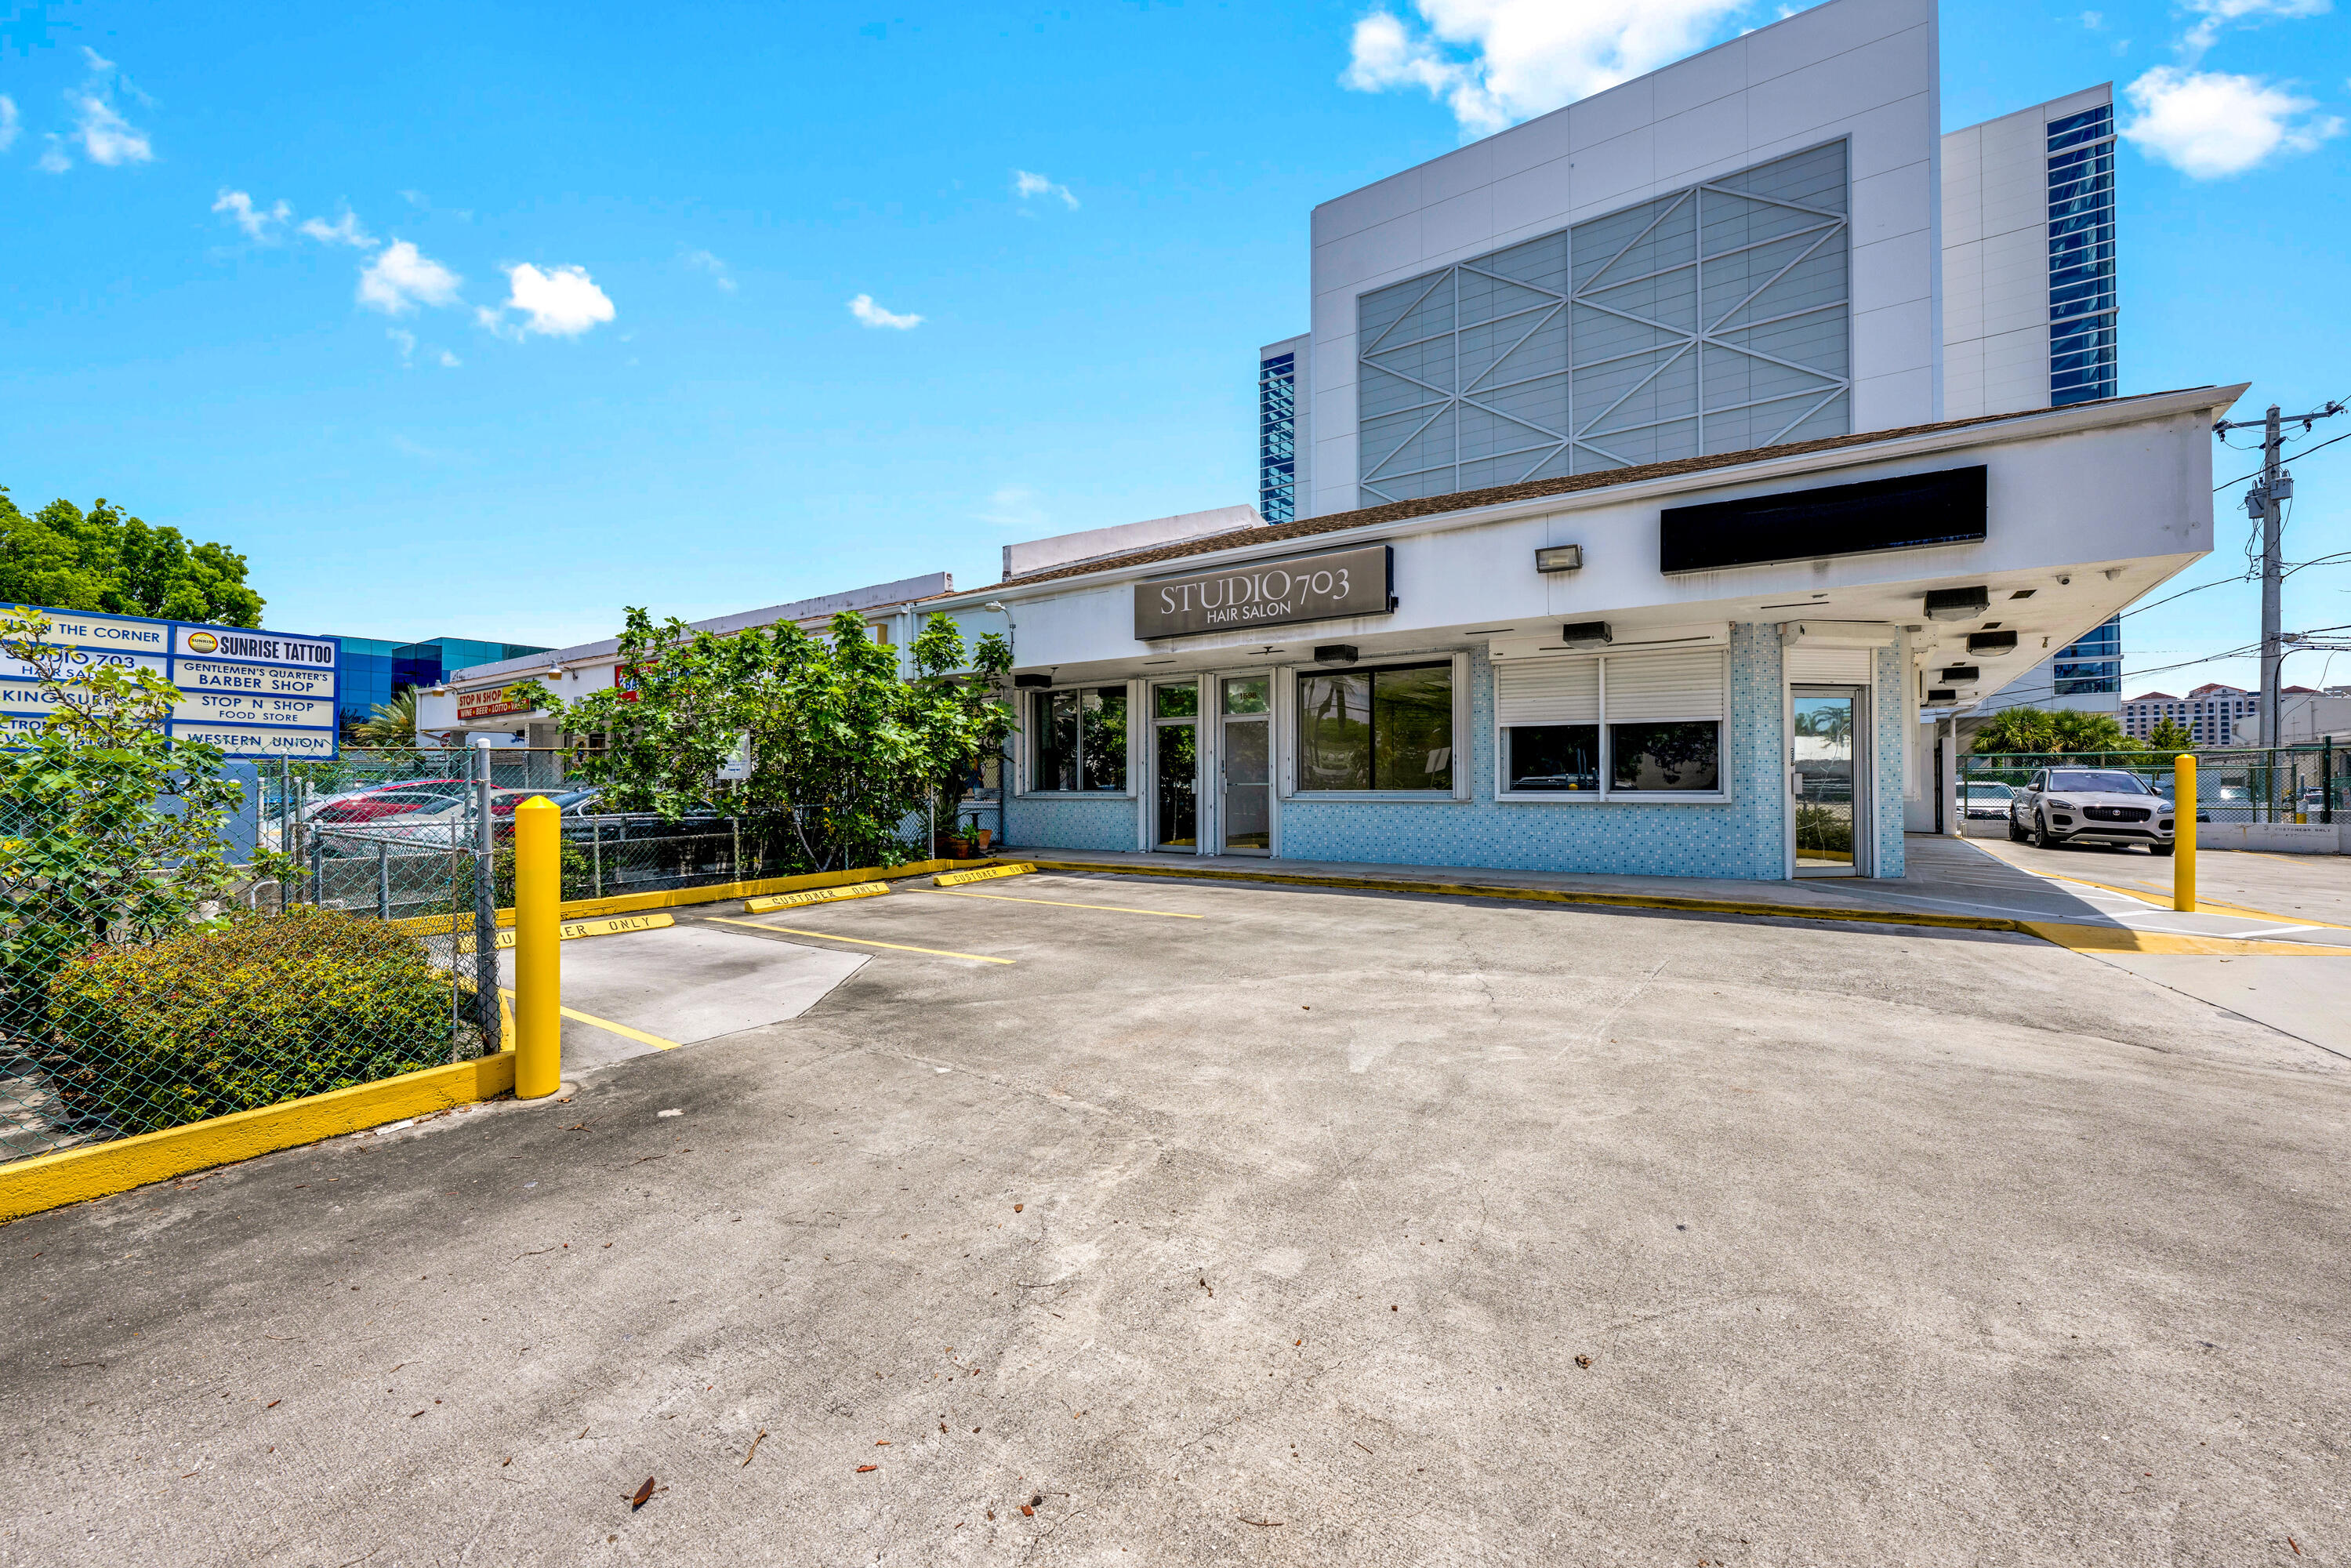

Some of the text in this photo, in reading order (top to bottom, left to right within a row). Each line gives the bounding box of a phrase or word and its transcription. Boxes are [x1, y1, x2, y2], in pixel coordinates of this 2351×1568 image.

[1160, 568, 1350, 615] STUDIO 703
[1207, 601, 1291, 624] HAIR SALON
[59, 623, 87, 637] THE
[94, 627, 160, 643] CORNER
[220, 636, 332, 664] SUNRISE TATTOO
[184, 662, 328, 681] GENTLEMEN'S QUARTER'S
[199, 674, 314, 692] BARBER SHOP
[201, 695, 314, 712] STOP N SHOP
[459, 694, 475, 706] STOP
[476, 693, 481, 704] N
[483, 690, 502, 703] SHOP
[219, 710, 298, 722] FOOD STORE
[460, 709, 472, 717] WINE
[476, 706, 488, 716] BEER
[492, 703, 508, 713] LOTTO
[187, 733, 324, 748] WESTERN UNION
[953, 863, 1031, 883] CUSTOMER ONLY
[771, 884, 880, 906] CUSTOMER ONLY
[609, 917, 650, 931] ONLY
